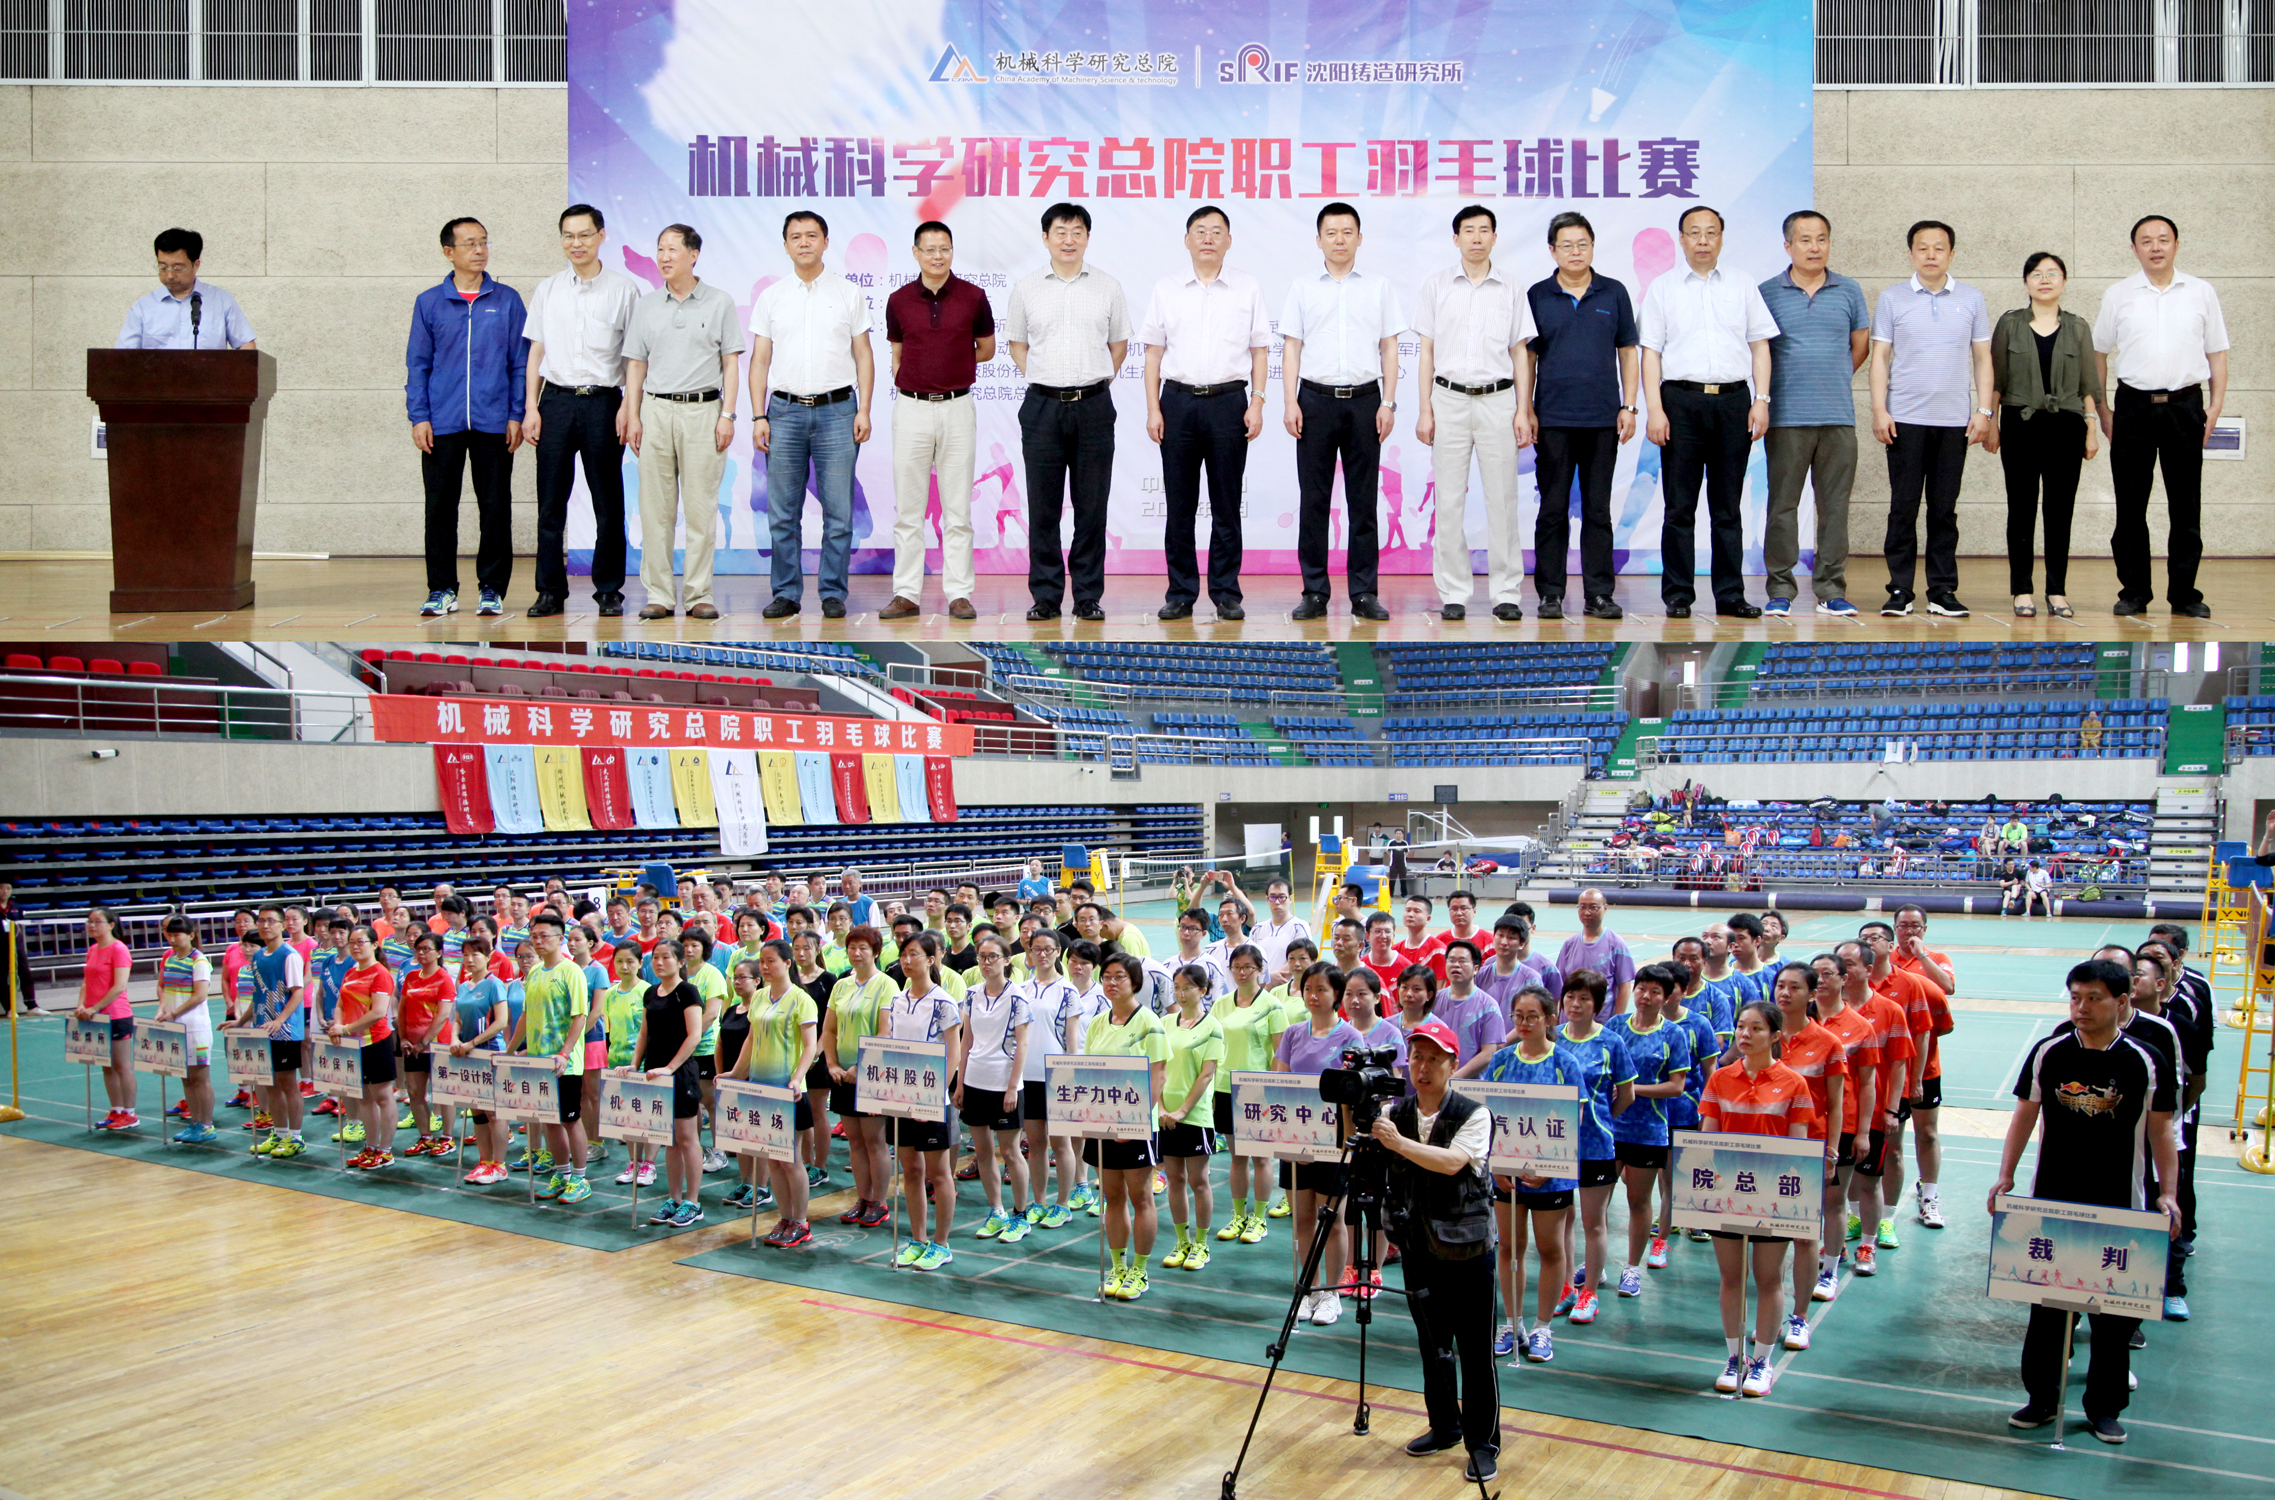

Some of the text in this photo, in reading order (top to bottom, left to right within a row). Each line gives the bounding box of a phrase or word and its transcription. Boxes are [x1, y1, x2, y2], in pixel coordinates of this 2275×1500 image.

[995, 51, 1178, 73] 机械科学研究总院
[1306, 62, 1462, 83] 沈阳铸造研究所
[995, 75, 1016, 83] China
[1017, 75, 1050, 84] Academy
[1061, 76, 1099, 85] Machinery
[1100, 76, 1127, 84] Science
[1128, 76, 1135, 84] &
[1137, 77, 1177, 86] technology
[688, 135, 1701, 200] 机械科学研究总院职工羽毛球比赛
[437, 701, 942, 750] 机械科学研究总院职工羽毛球比赛
[254, 970, 269, 994] YONEX
[141, 1037, 179, 1055] 沈铸所
[319, 1056, 355, 1073] 材保所
[438, 1065, 493, 1085] 第一设计院
[866, 1064, 936, 1088] 机科股份
[503, 1079, 549, 1096] 北自所
[1056, 1084, 1140, 1105] 生产力中心
[610, 1094, 663, 1116] 机电所
[1244, 1102, 1338, 1126] 研究中心
[726, 1105, 783, 1130] 试验场
[1692, 1168, 1802, 1197] 院总部
[2028, 1237, 2128, 1271] 裁判
